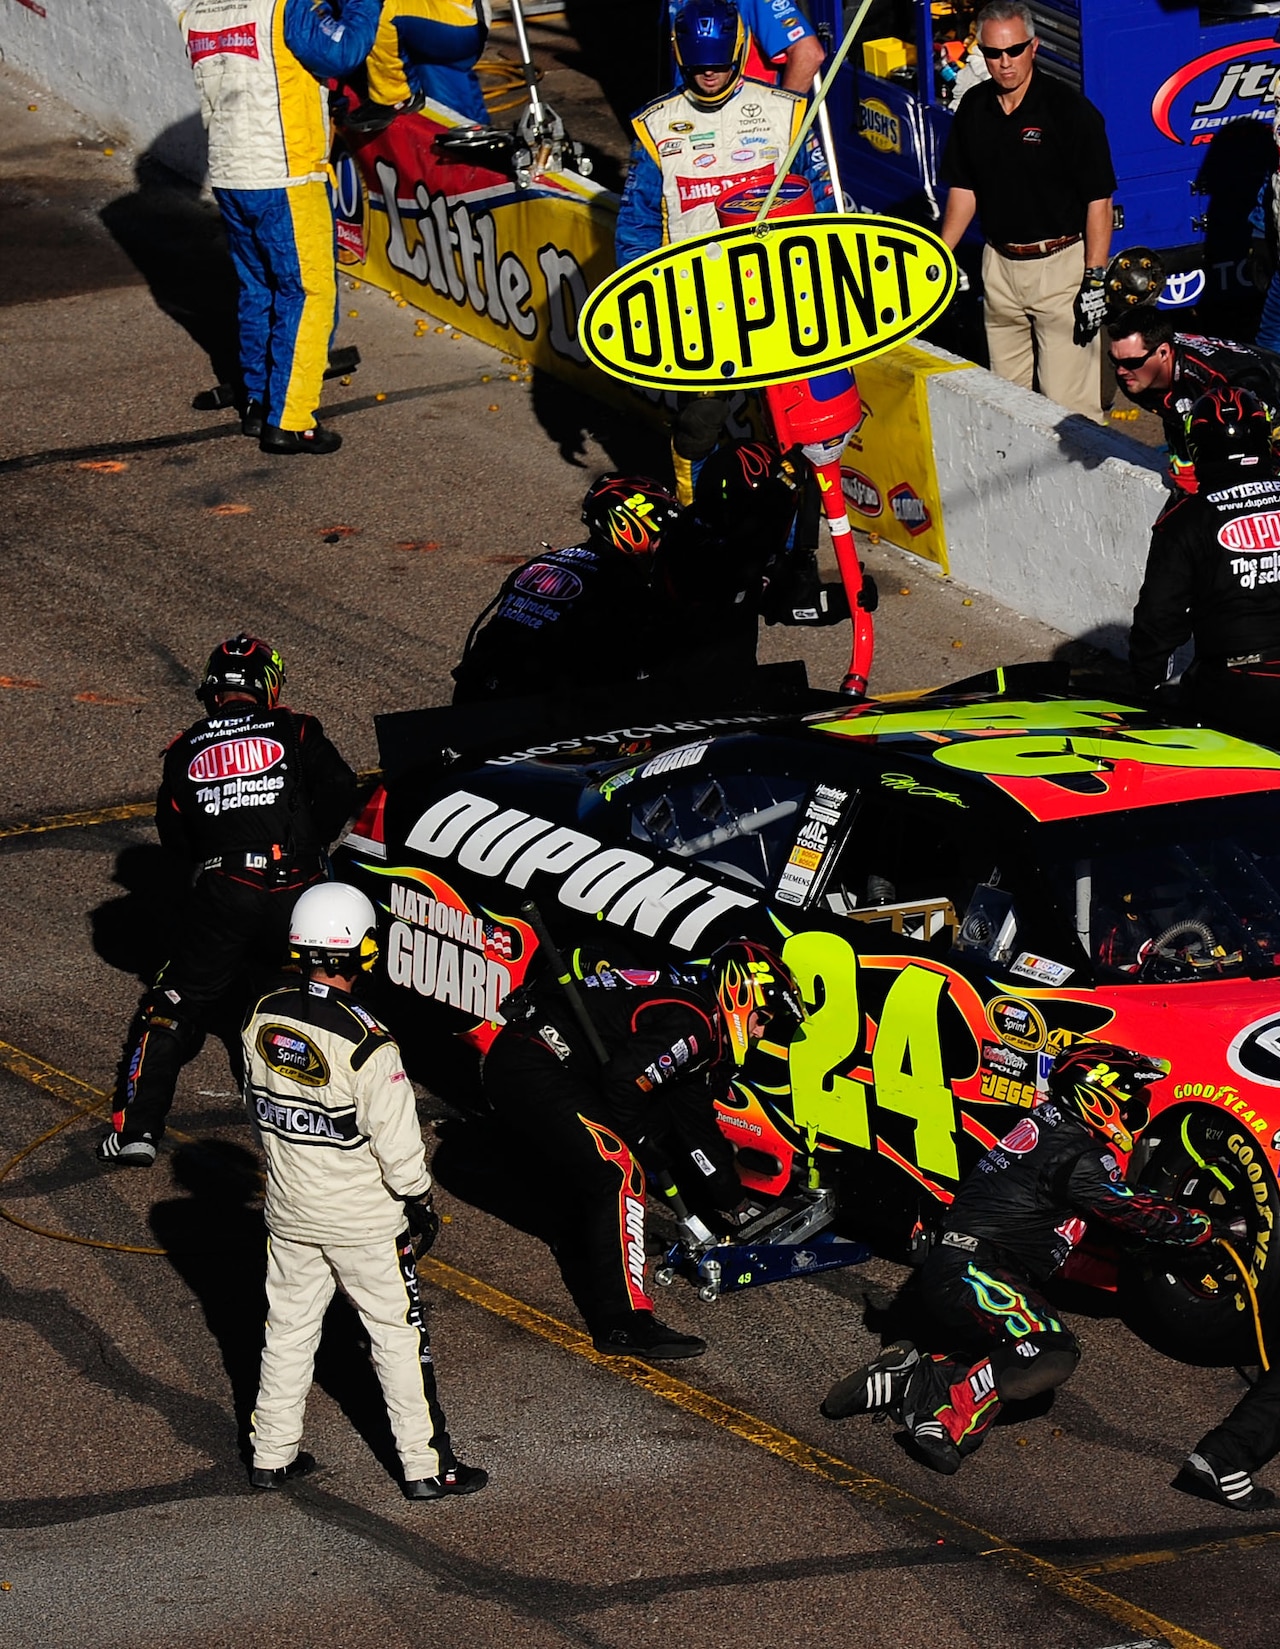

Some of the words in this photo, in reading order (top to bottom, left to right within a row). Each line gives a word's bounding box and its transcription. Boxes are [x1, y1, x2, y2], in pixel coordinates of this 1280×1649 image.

[680, 180, 722, 201] Little
[375, 160, 538, 338] Little
[1230, 556, 1258, 575] The
[1240, 570, 1258, 590] of
[189, 721, 276, 746] www.dupont.com
[641, 745, 709, 778] GUARD
[223, 775, 285, 797] miracles
[796, 837, 826, 853] TOOLS
[798, 820, 829, 845] MAC
[404, 789, 760, 952] DUPONT
[782, 871, 811, 888] SIEMENS
[390, 882, 487, 951] NATIONAL
[387, 921, 512, 1027] GUARD
[1014, 964, 1037, 978] RACE
[1037, 972, 1059, 984] CAR
[1003, 1017, 1027, 1034] Sprint
[276, 1034, 308, 1053] NASCAR
[782, 930, 960, 1182] 24
[277, 1048, 309, 1067] Sprint
[988, 1061, 1022, 1078] POLE
[1087, 1062, 1121, 1089] 24
[981, 1074, 1037, 1109] JEGS
[256, 1096, 344, 1140] OFFICIAL
[1173, 1083, 1269, 1134] GOODYEAR
[625, 1195, 648, 1297] DUPONT
